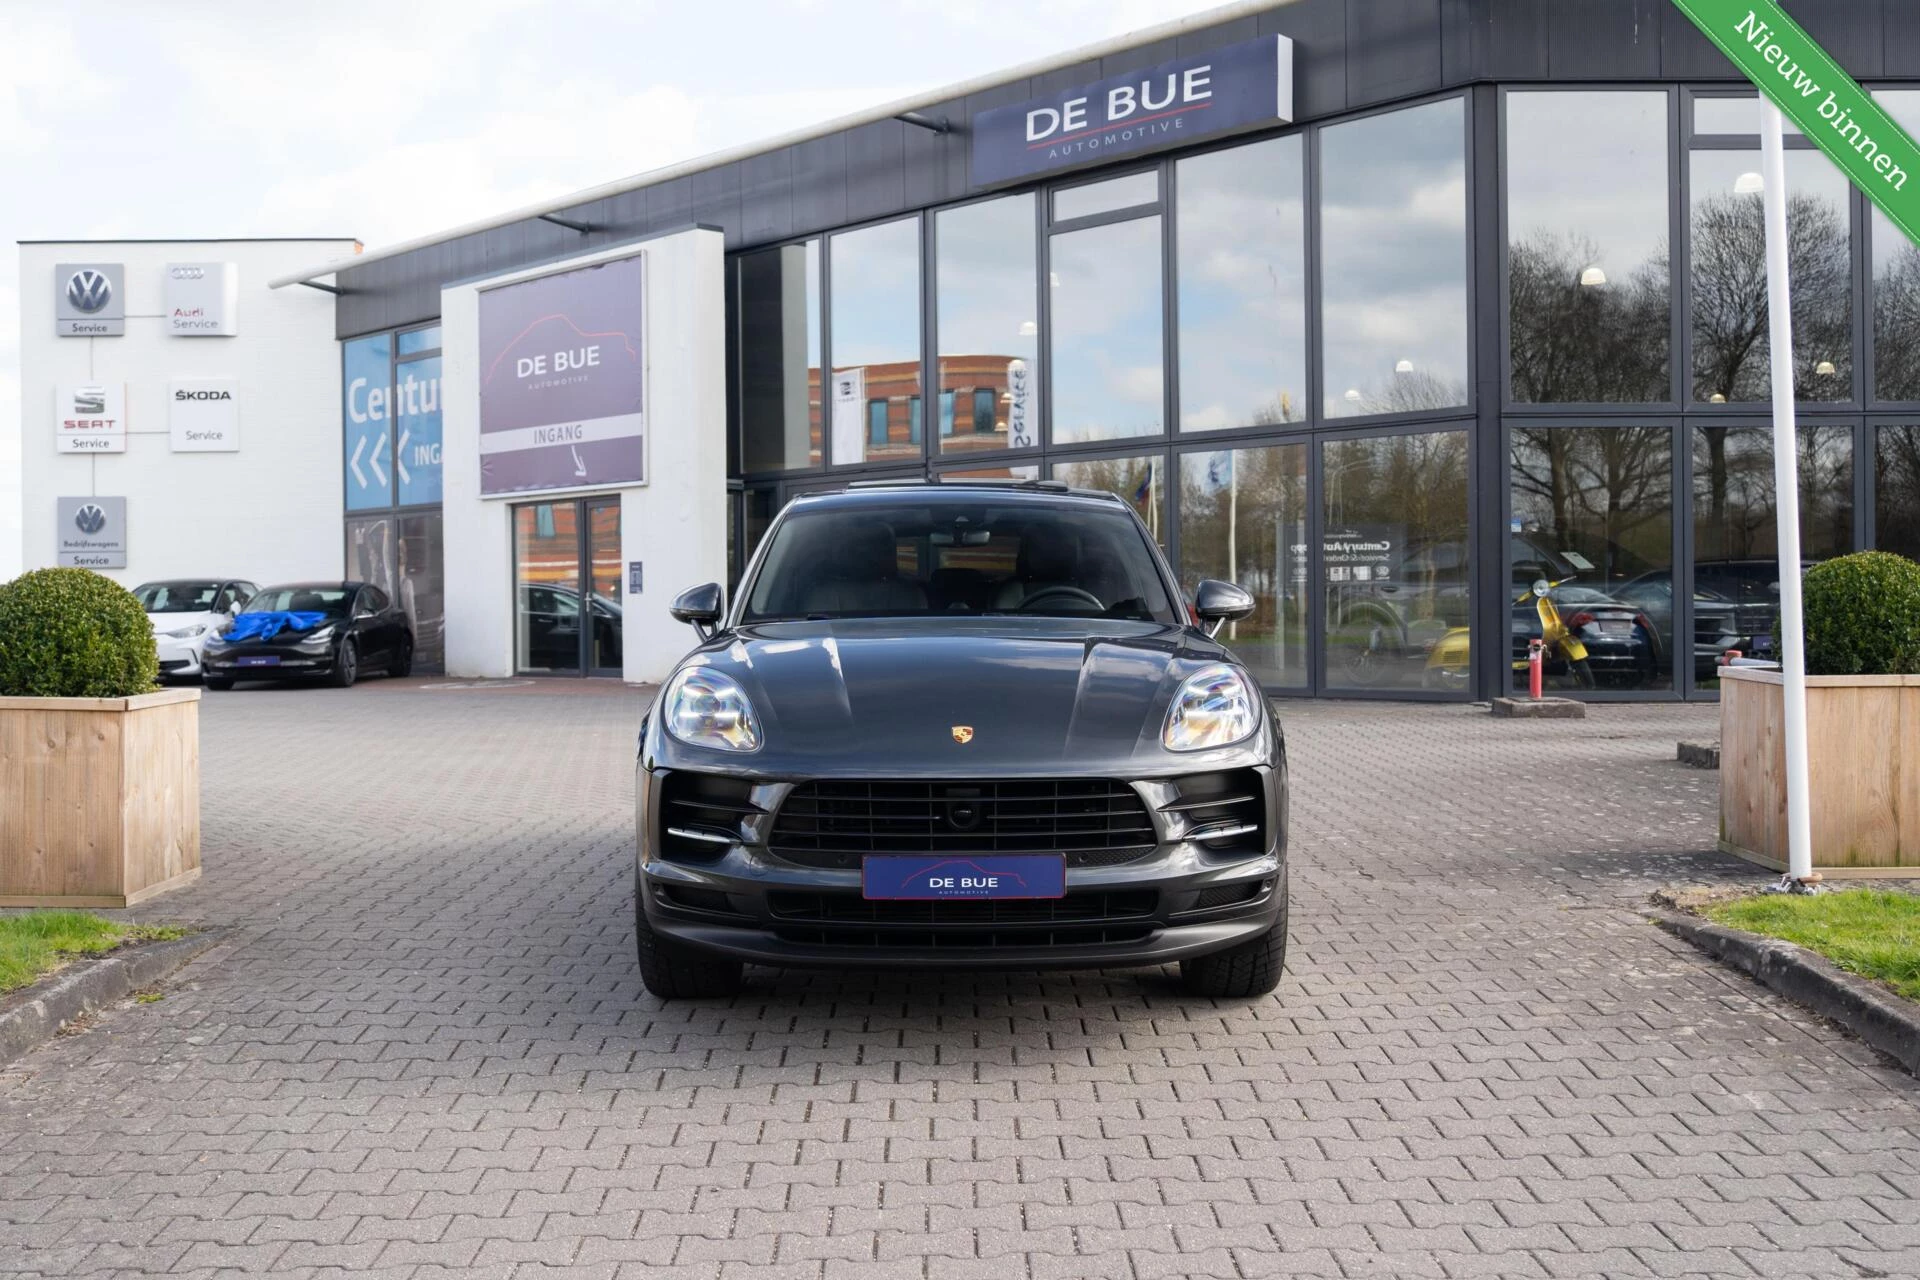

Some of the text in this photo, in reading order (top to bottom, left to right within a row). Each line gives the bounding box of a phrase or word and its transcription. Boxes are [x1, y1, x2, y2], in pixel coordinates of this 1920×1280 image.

[1026, 65, 1212, 142] DE BUE
[1049, 118, 1184, 159] AUTOMOTIVE
[174, 308, 204, 317] Audi
[72, 323, 108, 333] Service
[173, 319, 218, 329] Service
[517, 345, 600, 378] DE BUE
[528, 375, 588, 390] AUTOMOTIVE
[175, 389, 232, 401] ŠKODA
[348, 374, 443, 423] Centu
[63, 419, 116, 429] SEAT
[185, 430, 223, 440] Service
[534, 424, 583, 445] INGANG
[72, 439, 110, 449] Service
[73, 555, 109, 565] Service
[929, 877, 999, 888] DE BUE
